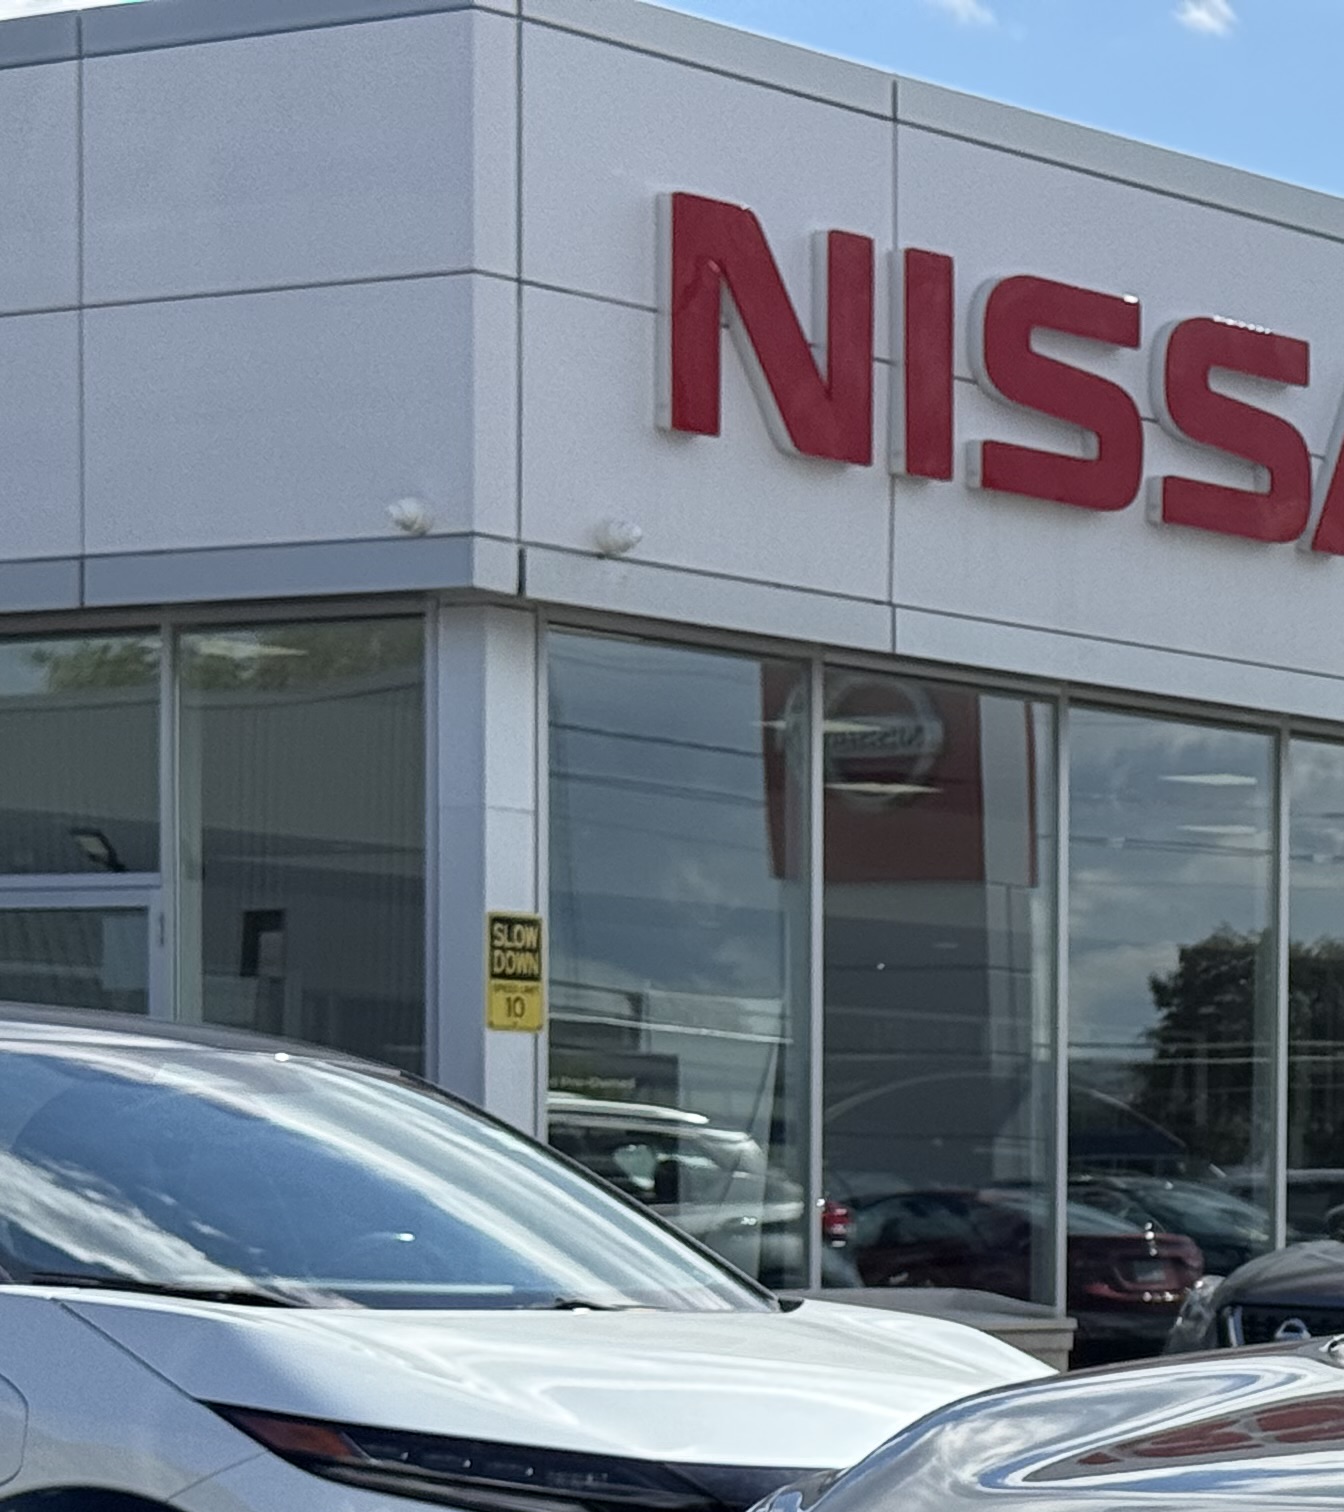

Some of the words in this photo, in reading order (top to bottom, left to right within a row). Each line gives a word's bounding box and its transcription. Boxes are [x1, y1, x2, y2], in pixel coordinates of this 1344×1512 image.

[493, 922, 539, 949] SLOW
[493, 950, 539, 976] DOWN
[506, 996, 525, 1018] 10
